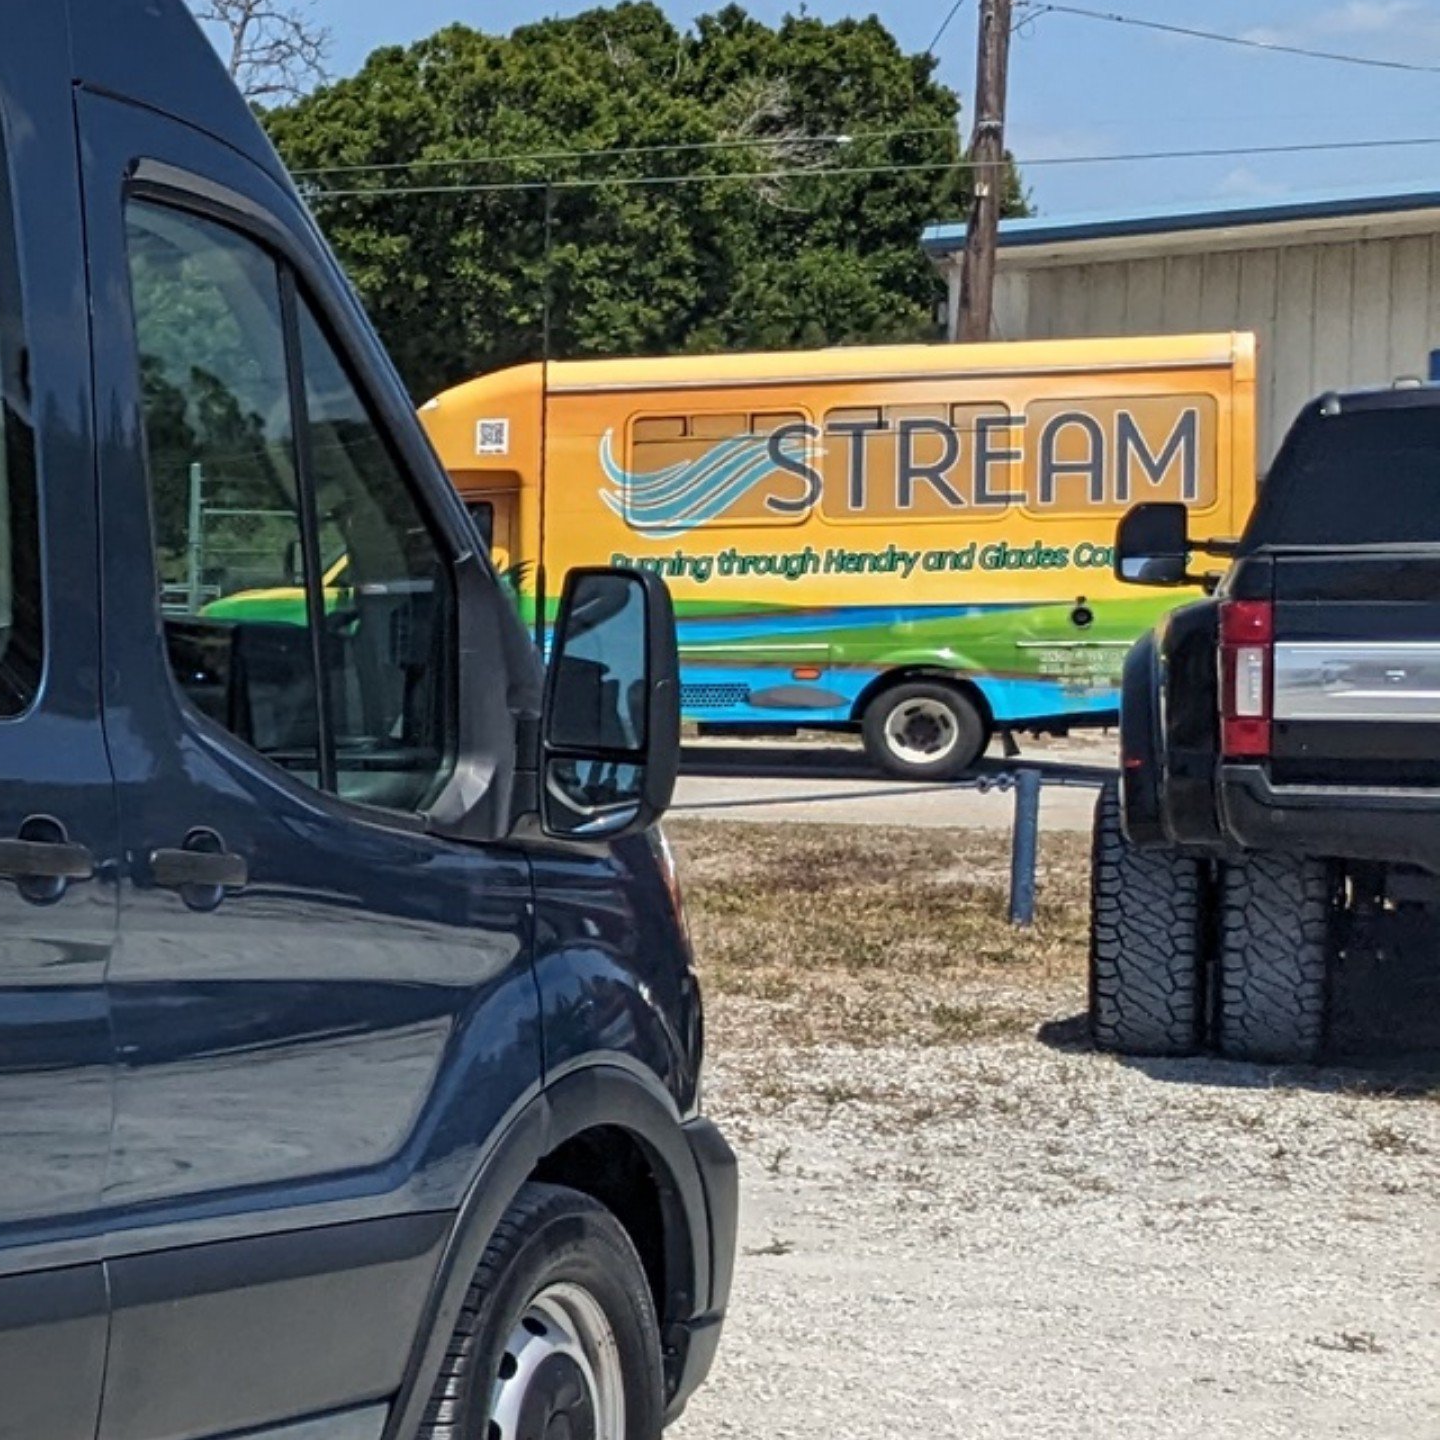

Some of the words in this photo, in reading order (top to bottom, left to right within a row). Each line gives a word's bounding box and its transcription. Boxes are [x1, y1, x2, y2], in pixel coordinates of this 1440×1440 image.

[765, 408, 1198, 513] STREAM
[717, 548, 818, 581] through
[823, 547, 920, 579] Hendry
[921, 543, 977, 572] and
[980, 541, 1068, 571] Glades
